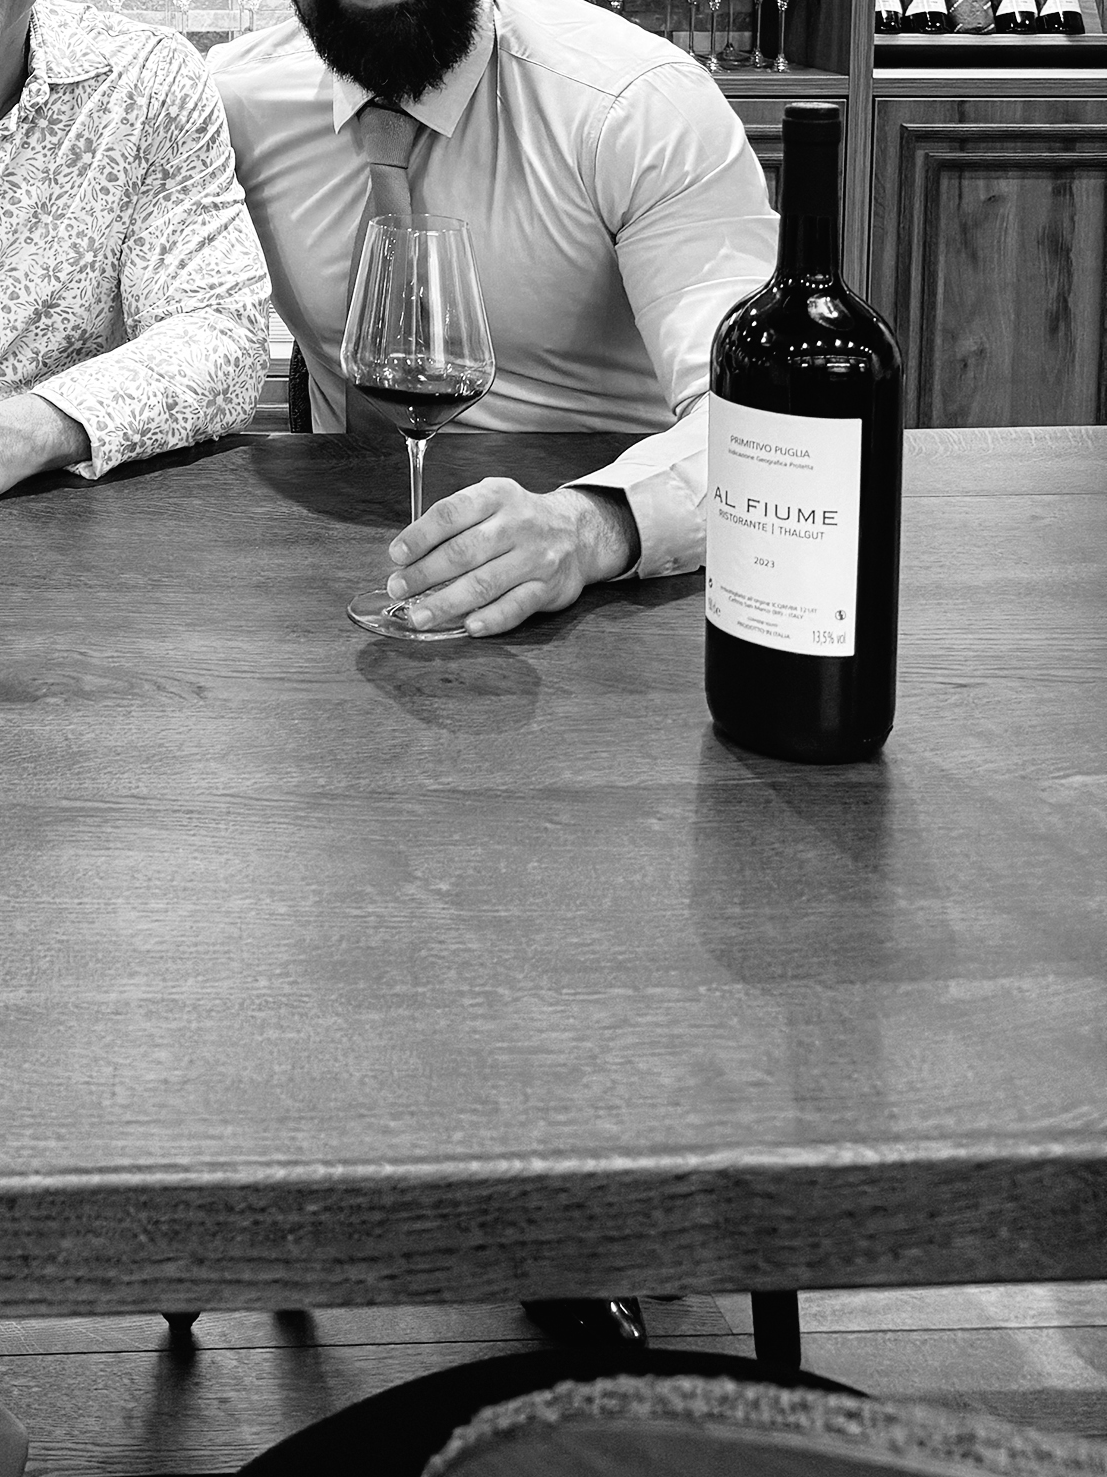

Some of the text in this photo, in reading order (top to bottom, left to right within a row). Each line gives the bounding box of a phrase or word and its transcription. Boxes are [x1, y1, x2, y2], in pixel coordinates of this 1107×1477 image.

[730, 435, 811, 459] PRIMITIVO PUGLIA
[714, 486, 838, 526] AL FIUME
[718, 508, 768, 532] RISTORANTE
[778, 526, 825, 540] THALGUT
[754, 557, 775, 569] 2023
[812, 630, 846, 646] 13,5% vol
